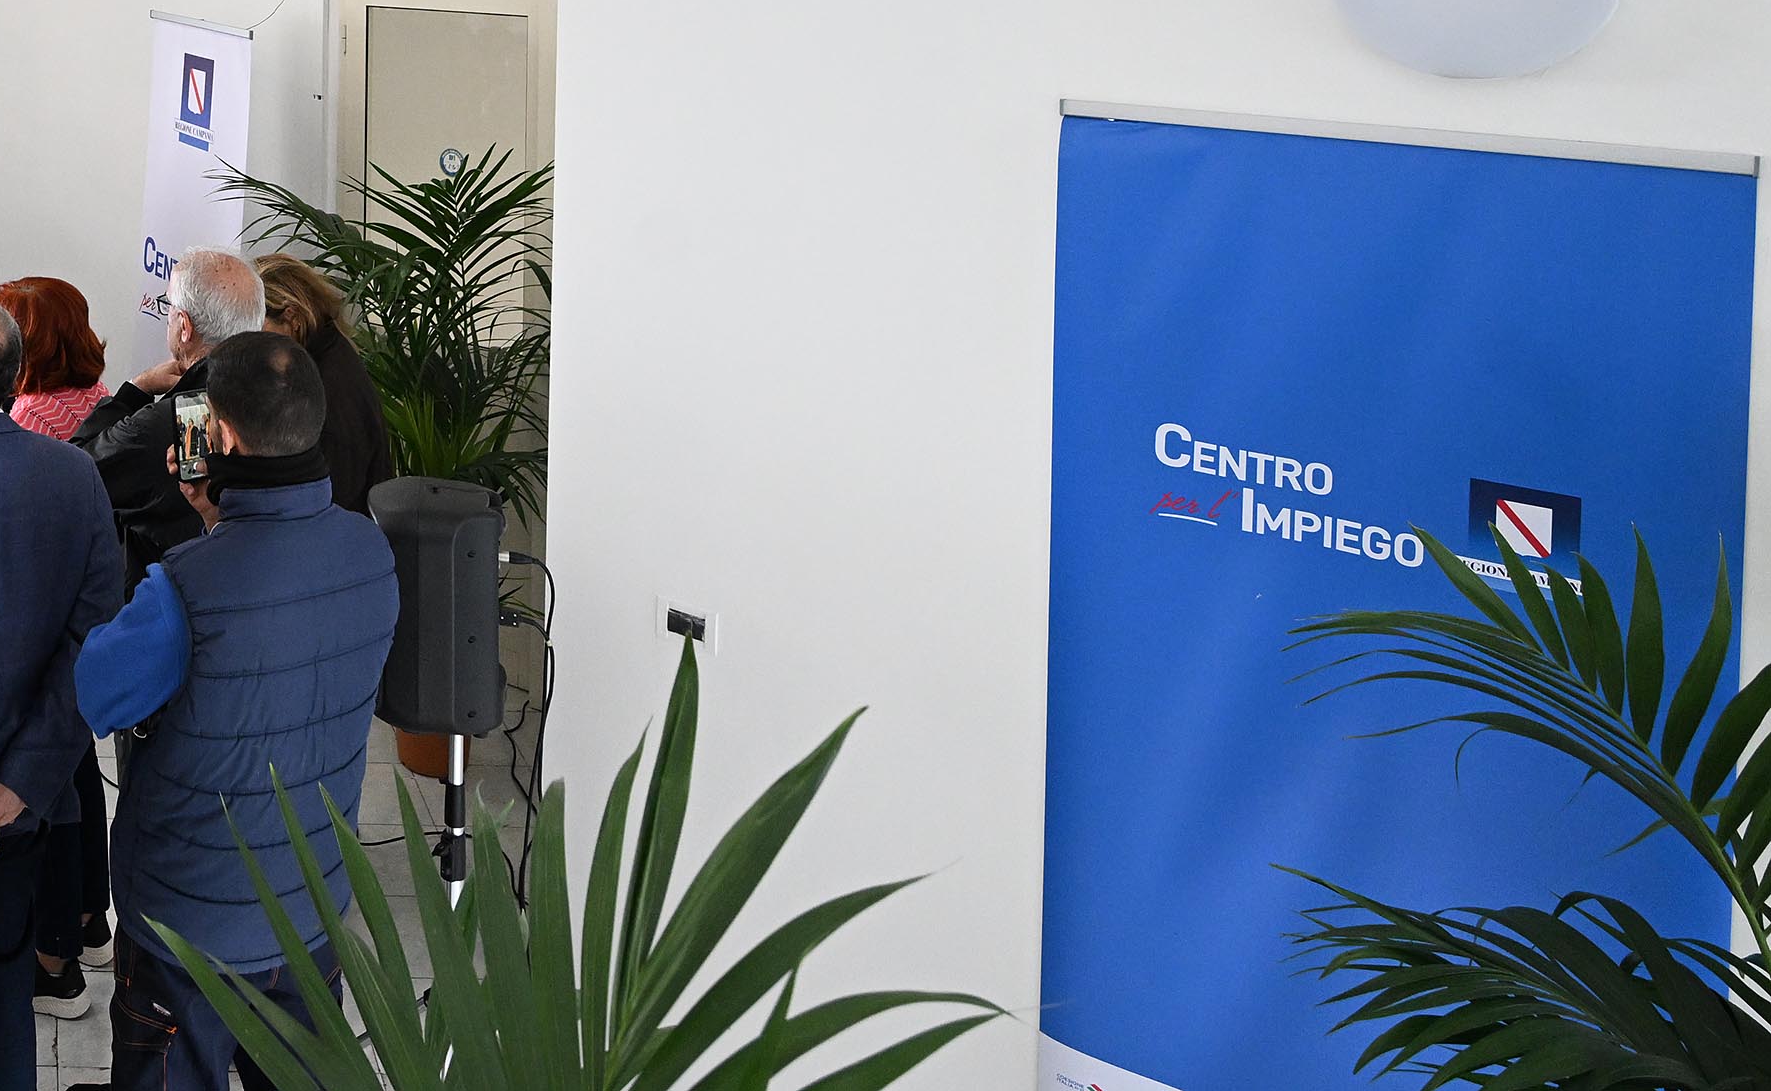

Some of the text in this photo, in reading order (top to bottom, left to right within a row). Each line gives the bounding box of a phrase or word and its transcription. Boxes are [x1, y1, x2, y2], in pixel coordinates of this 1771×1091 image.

[174, 121, 192, 135] REGIONE
[1154, 422, 1333, 496] CENTRO
[1149, 490, 1200, 515] per
